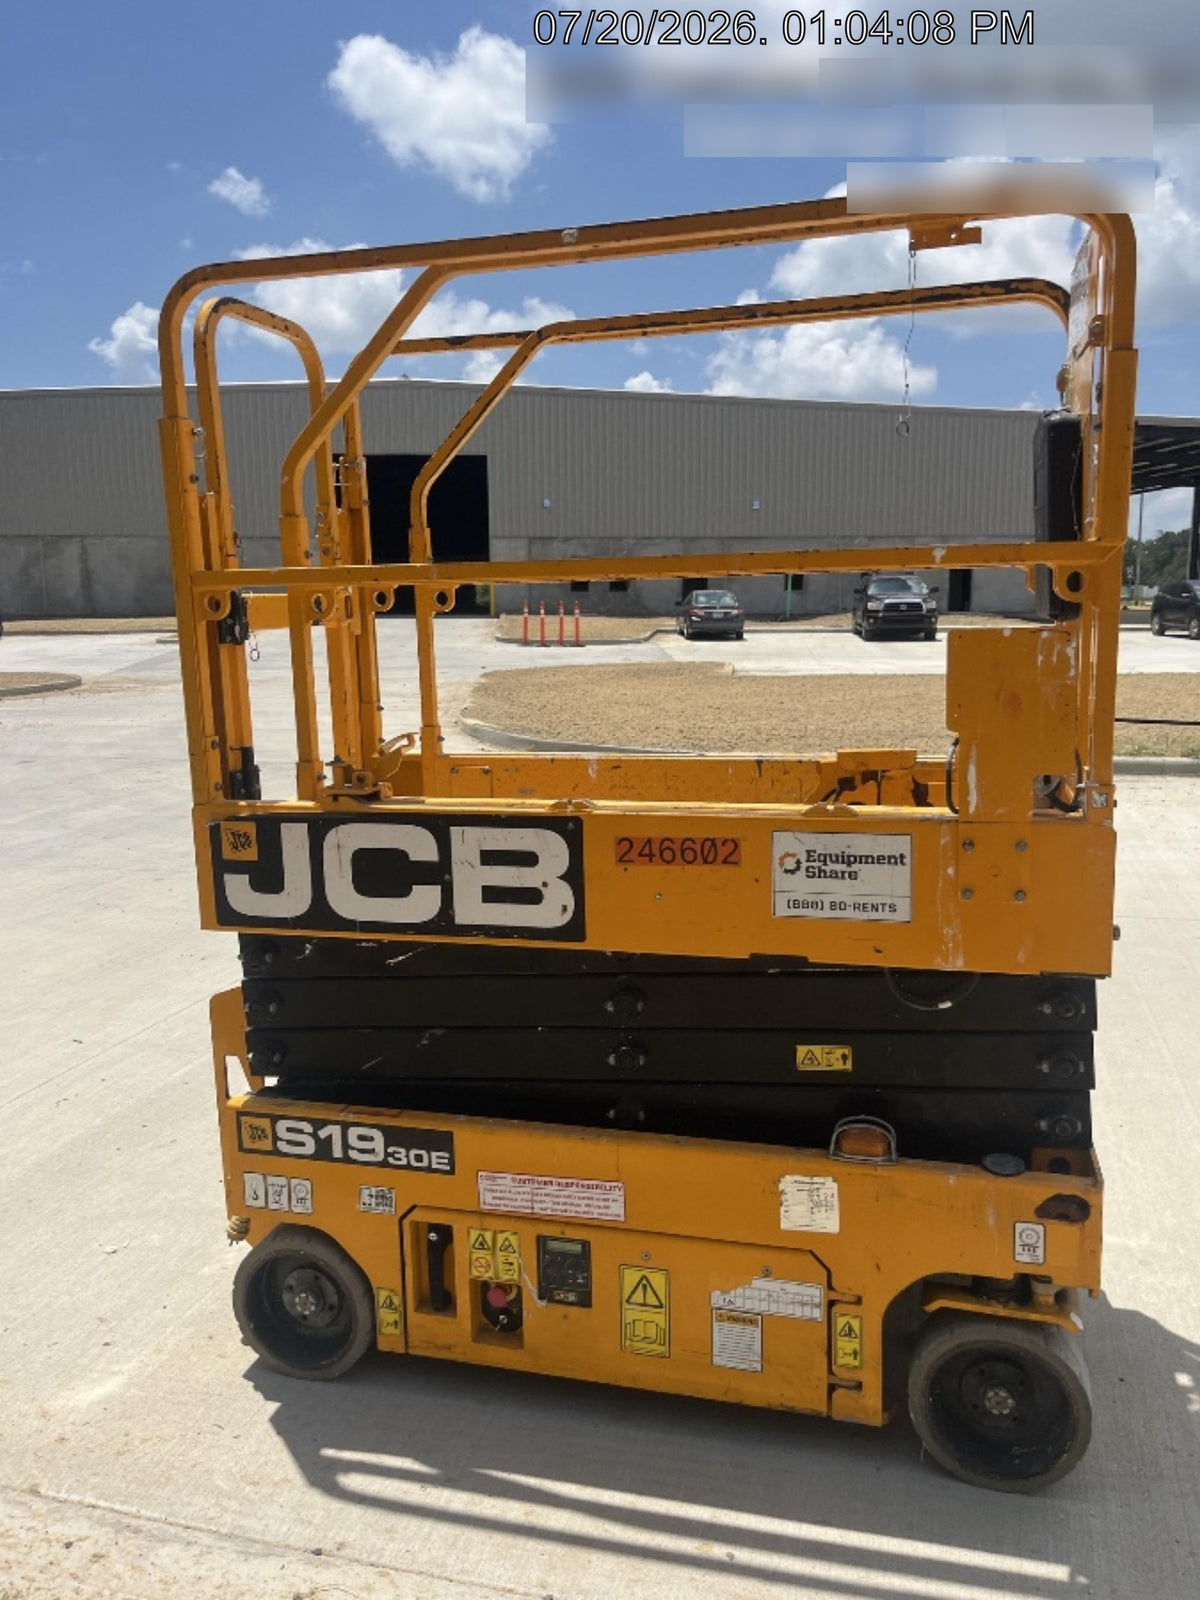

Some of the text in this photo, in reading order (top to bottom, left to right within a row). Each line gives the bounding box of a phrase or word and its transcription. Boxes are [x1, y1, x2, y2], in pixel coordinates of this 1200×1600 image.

[616, 837, 740, 865] 246602
[805, 849, 906, 867] Equipment
[223, 822, 575, 929] JCB
[805, 866, 858, 880] Share
[275, 1119, 450, 1170] S19 30E
